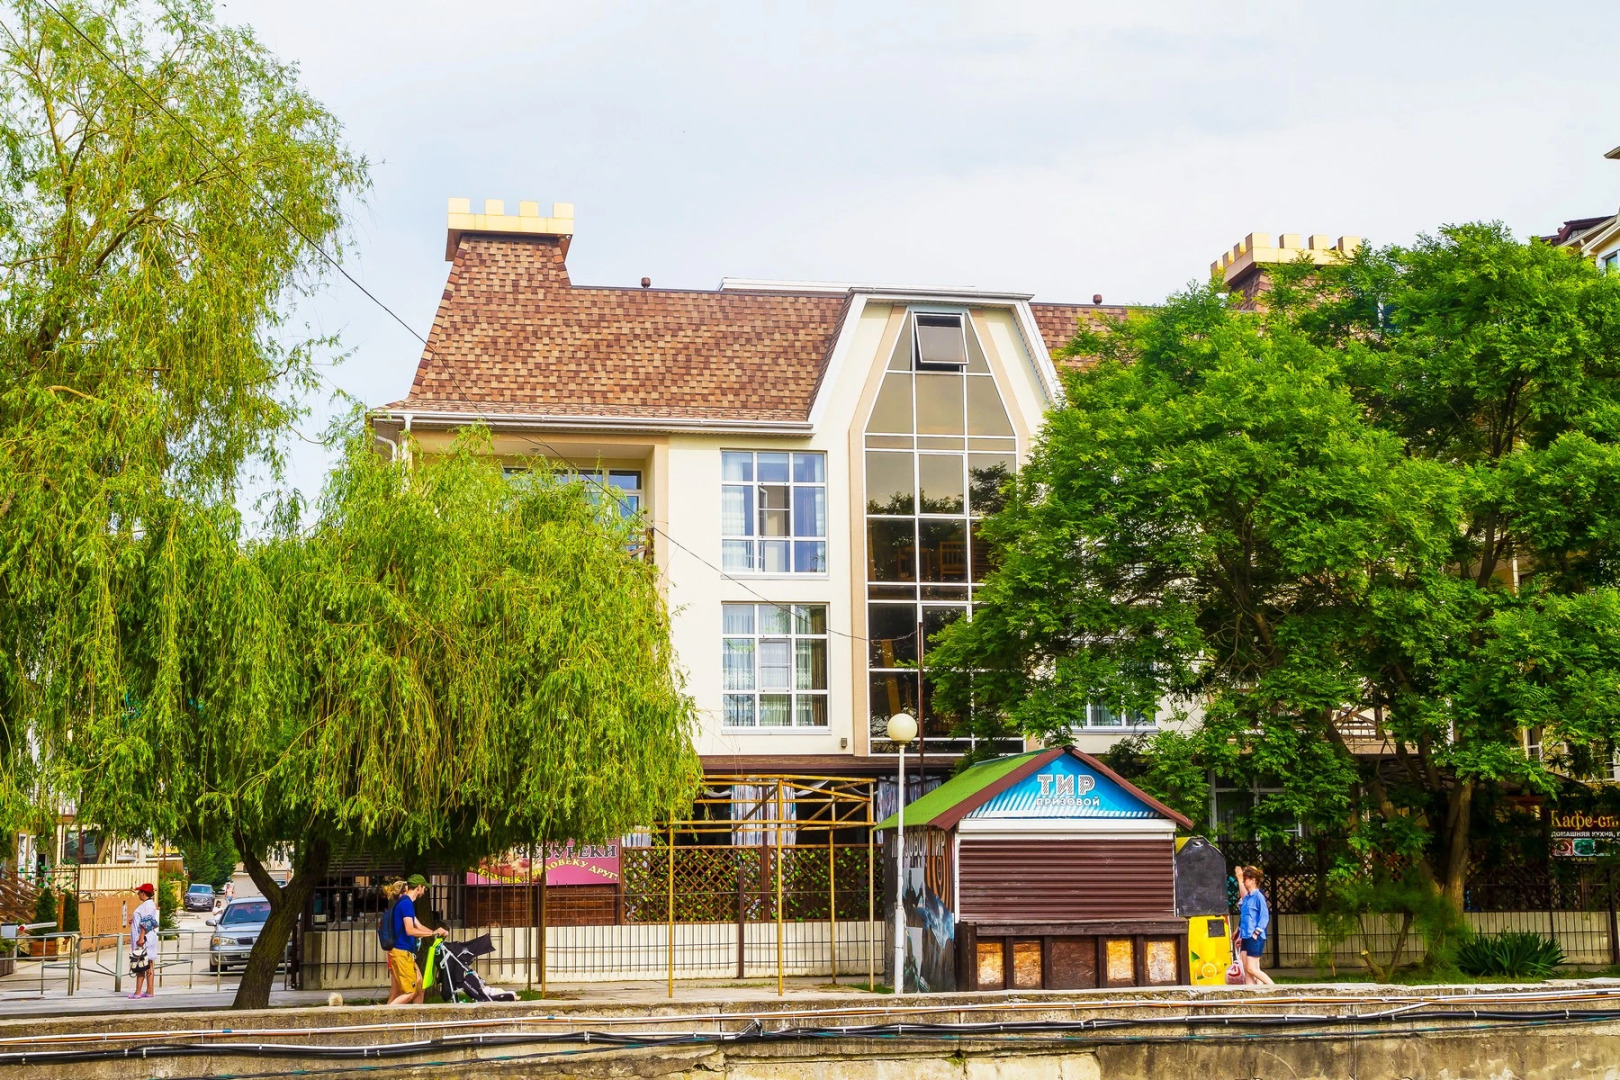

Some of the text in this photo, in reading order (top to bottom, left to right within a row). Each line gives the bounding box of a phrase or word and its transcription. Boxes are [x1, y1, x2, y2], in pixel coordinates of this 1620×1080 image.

[1037, 774, 1096, 796] ТИР
[1036, 796, 1100, 806] ПРИЗОВОЙ
[891, 830, 946, 858] ПЗОВОЙ ТИР
